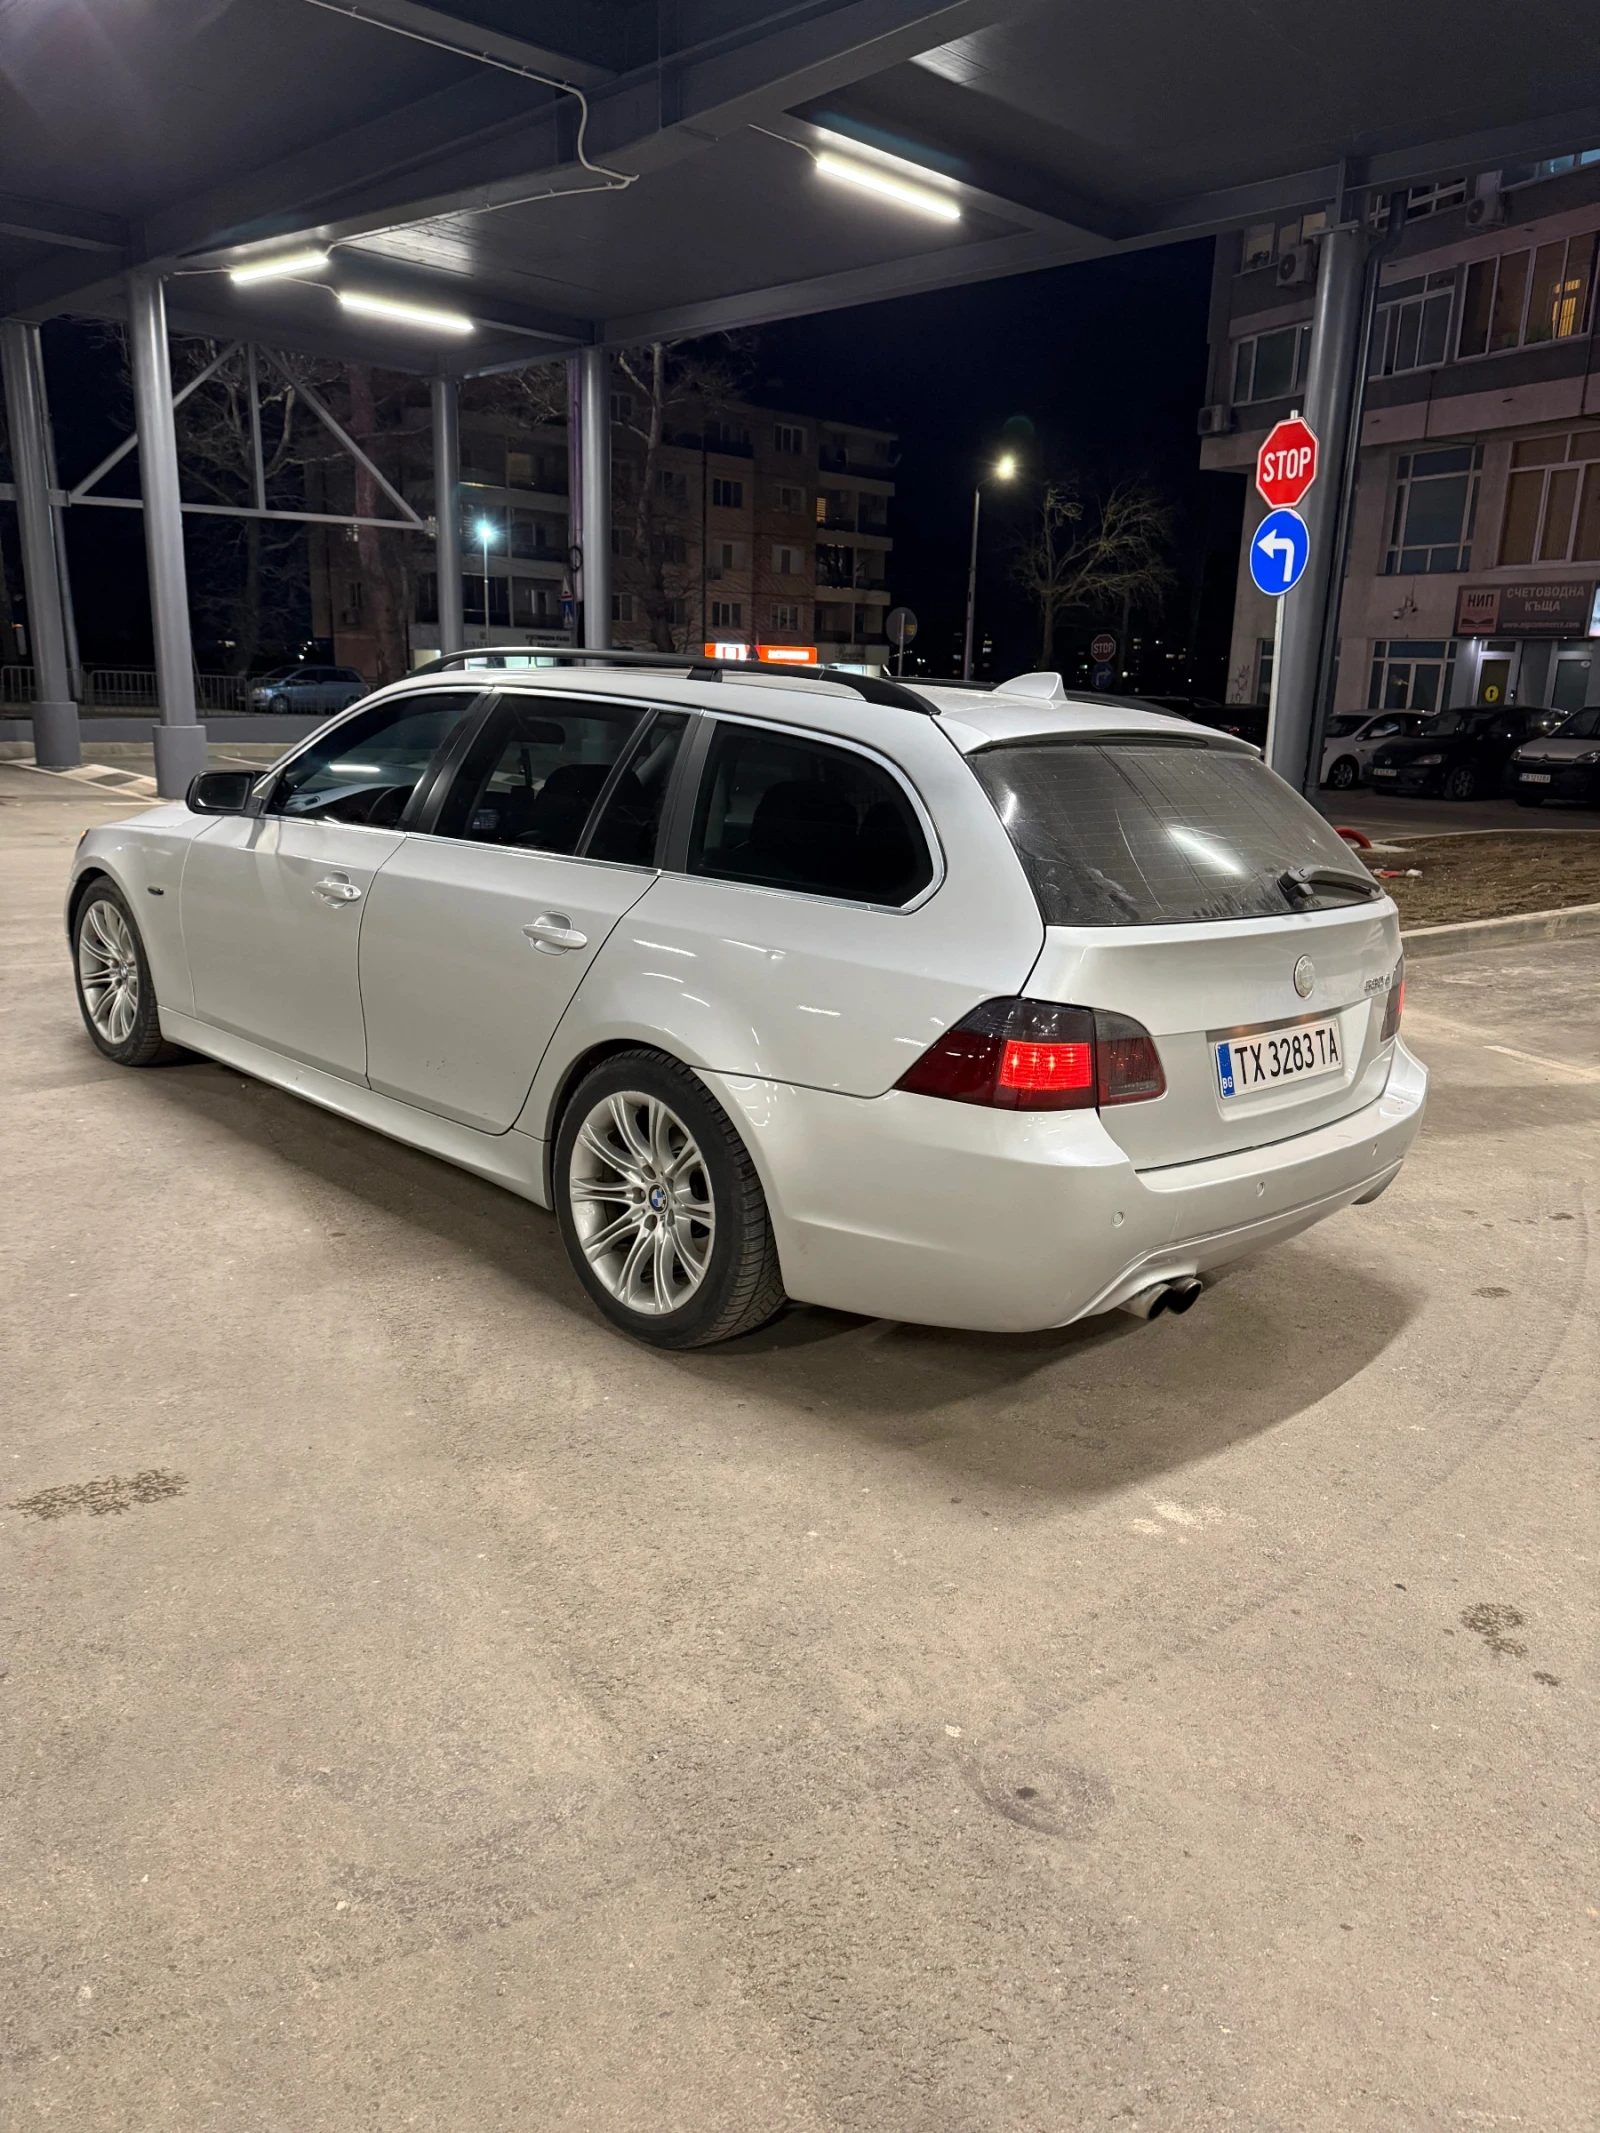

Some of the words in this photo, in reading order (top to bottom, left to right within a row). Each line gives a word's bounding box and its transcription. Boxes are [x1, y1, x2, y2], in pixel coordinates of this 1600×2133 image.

[1263, 446, 1311, 482] STOP
[1507, 586, 1585, 599] СЧЕТОВОДНА
[1468, 594, 1494, 607] НИП
[1524, 601, 1560, 612] КЪЩА
[1093, 642, 1113, 654] STOP
[1234, 1043, 1266, 1085] TX
[1268, 1033, 1315, 1077] 3283
[1315, 1027, 1339, 1065] TA
[1222, 1076, 1233, 1090] BG
